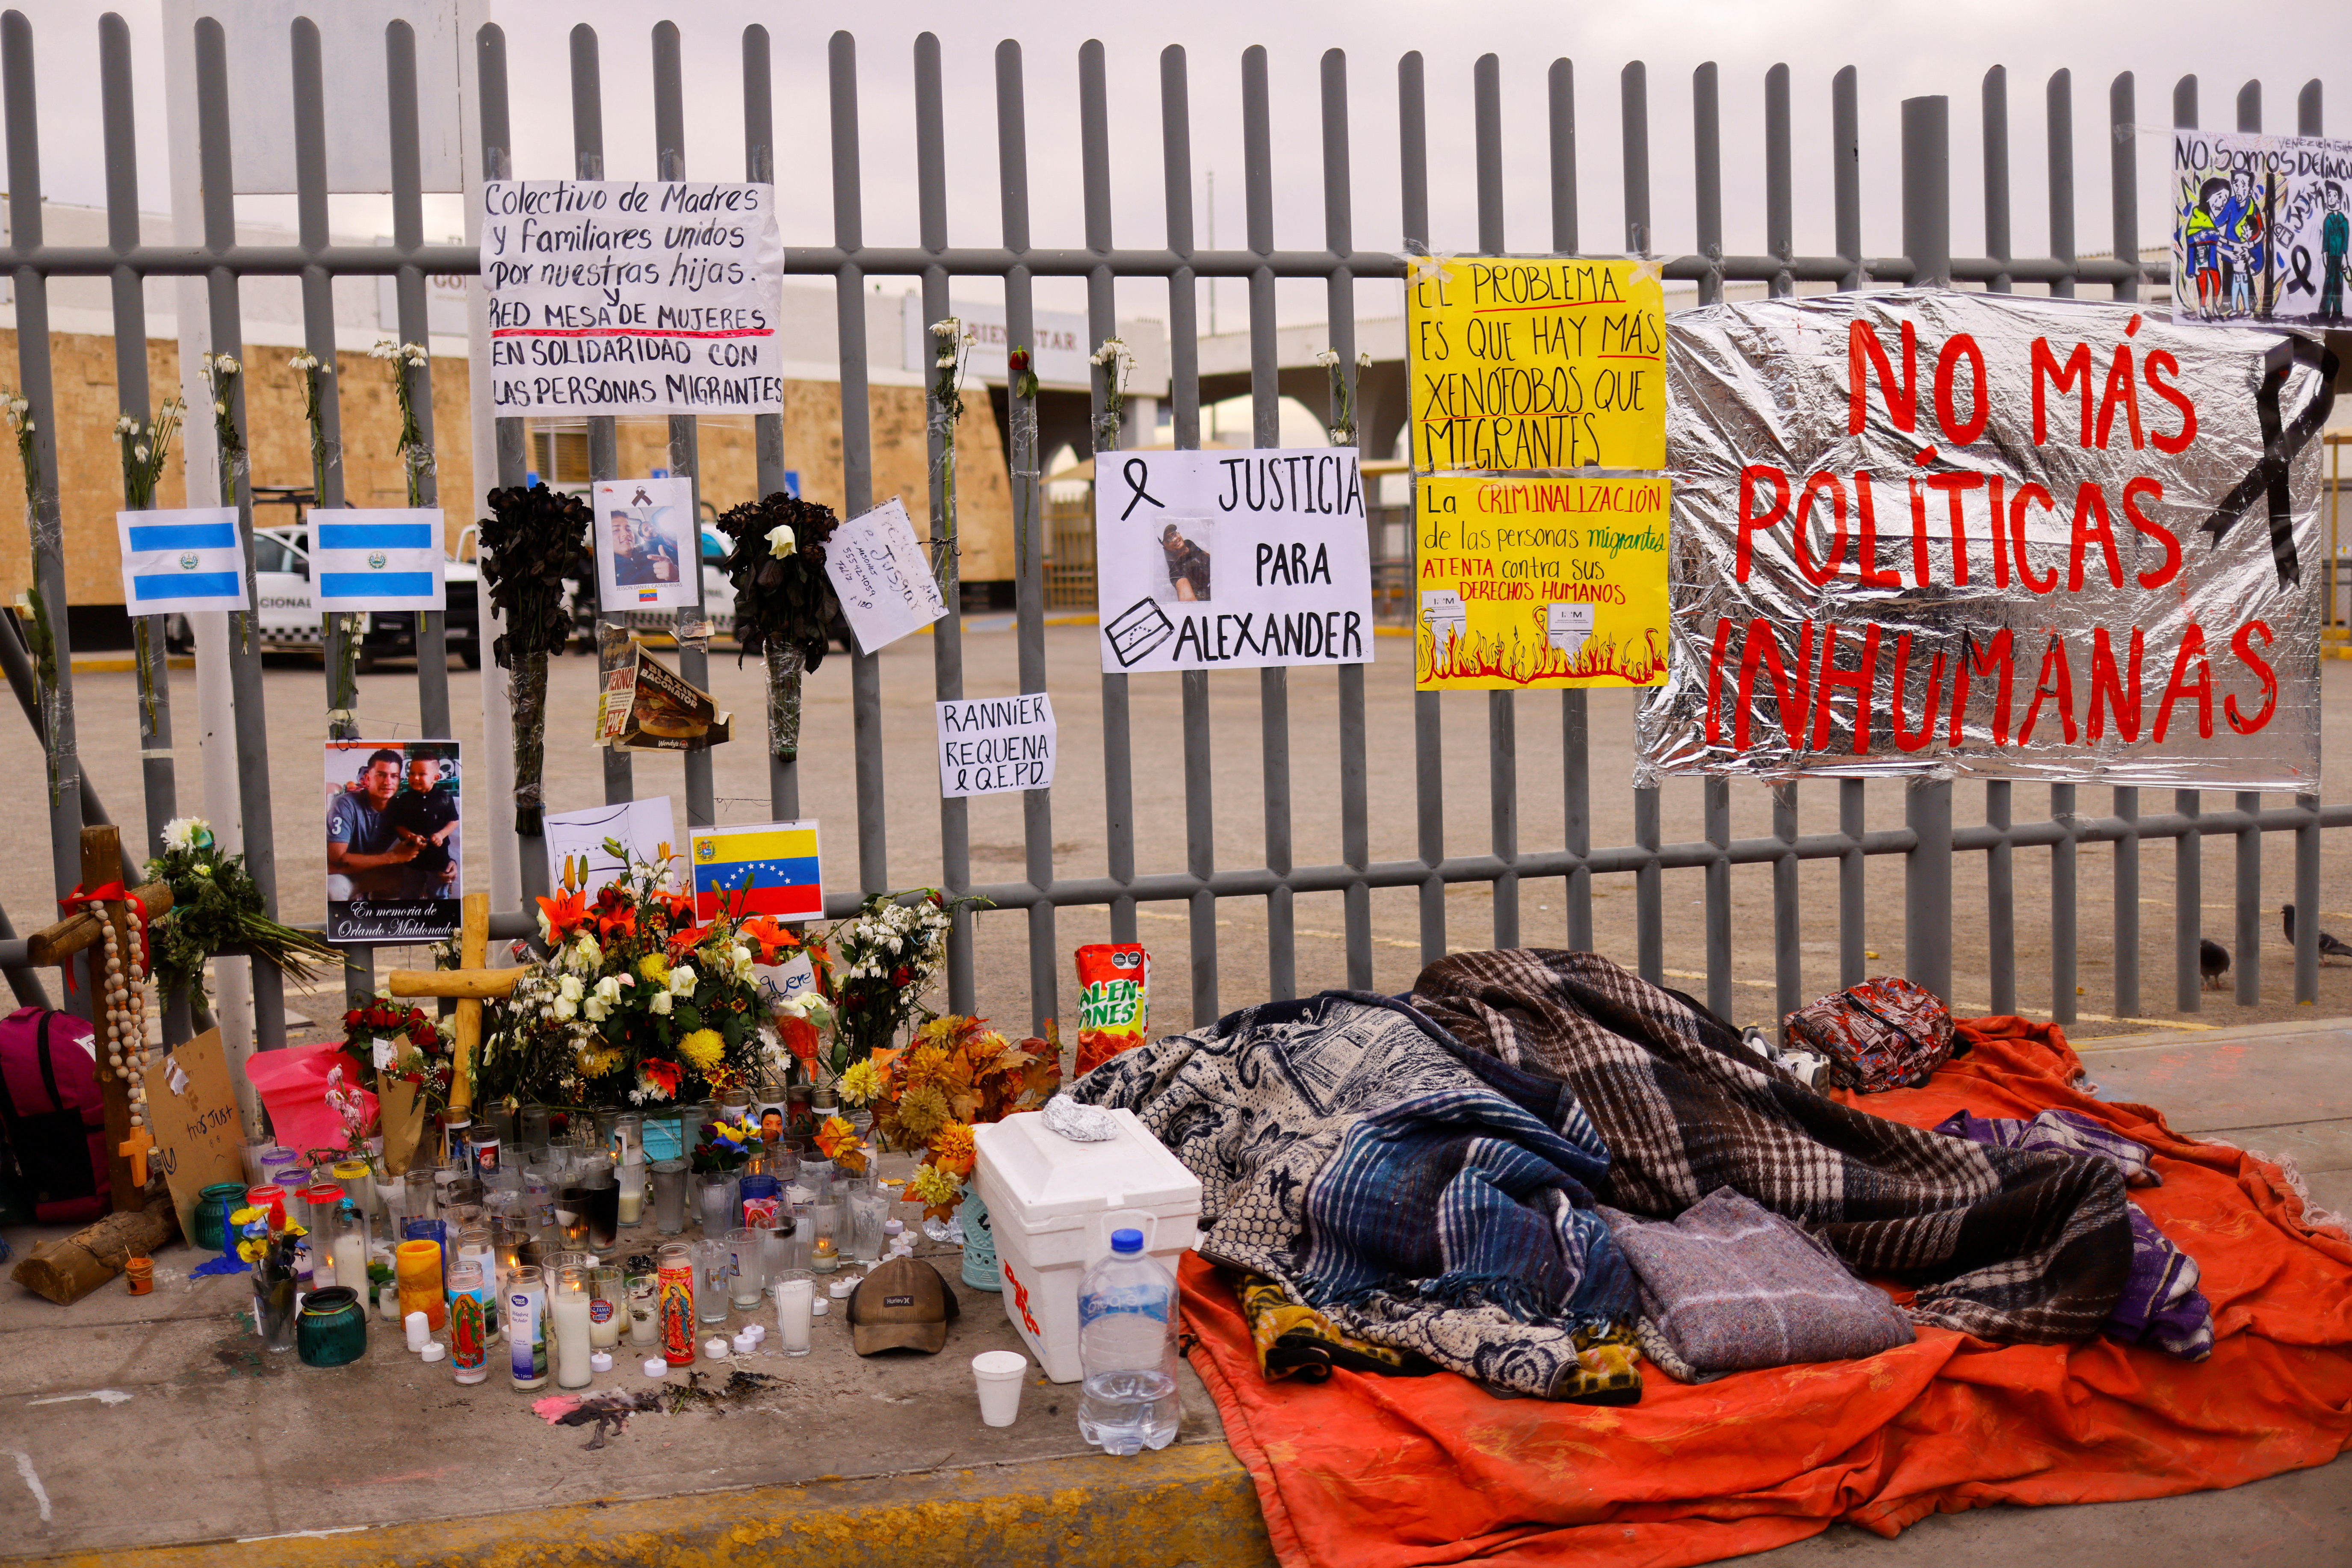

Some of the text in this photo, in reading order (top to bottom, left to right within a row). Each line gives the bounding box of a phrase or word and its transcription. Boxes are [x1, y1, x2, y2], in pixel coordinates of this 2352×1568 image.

[2175, 135, 2208, 170] NO
[486, 180, 758, 216] Colectivo de Madres
[493, 224, 506, 255] y
[540, 255, 659, 287] nuestras
[669, 253, 756, 291] hijas.
[1418, 263, 1619, 308] EL PROBLEMA
[489, 297, 766, 330] RED MESA DE MUJERES
[603, 288, 620, 307] y
[493, 336, 757, 367] EN SOLIDARIDAD CON
[1421, 309, 1660, 361] ES QUE HAY MÁS
[493, 374, 783, 407] LAS PERSONAS MIGRANTES
[1424, 366, 1646, 420] XENÓFOBOS QUE
[1848, 314, 2197, 454] NO MÁS
[1425, 413, 1600, 470] MIGRANTES
[1218, 455, 1364, 518] JUSTICIA
[1427, 484, 1661, 514] La CRIMINALIZACIÓN
[1736, 444, 2182, 594] POLÍTICAS
[1424, 520, 1665, 559] de las personas migrantes
[1256, 543, 1331, 587] PARA
[1423, 558, 1494, 578] ATENTA
[1502, 557, 1559, 579] contra
[1459, 581, 1626, 605] DERECHOS HUMANOS
[1173, 611, 1362, 661] ALEXANDER
[640, 668, 697, 709] BACONATOR
[1706, 617, 2277, 754] INHUMANAS
[946, 735, 1049, 767] REQUENA
[332, 817, 343, 835] 3
[338, 918, 453, 938] Orlando Maldonado
[351, 901, 437, 919] En memoria de
